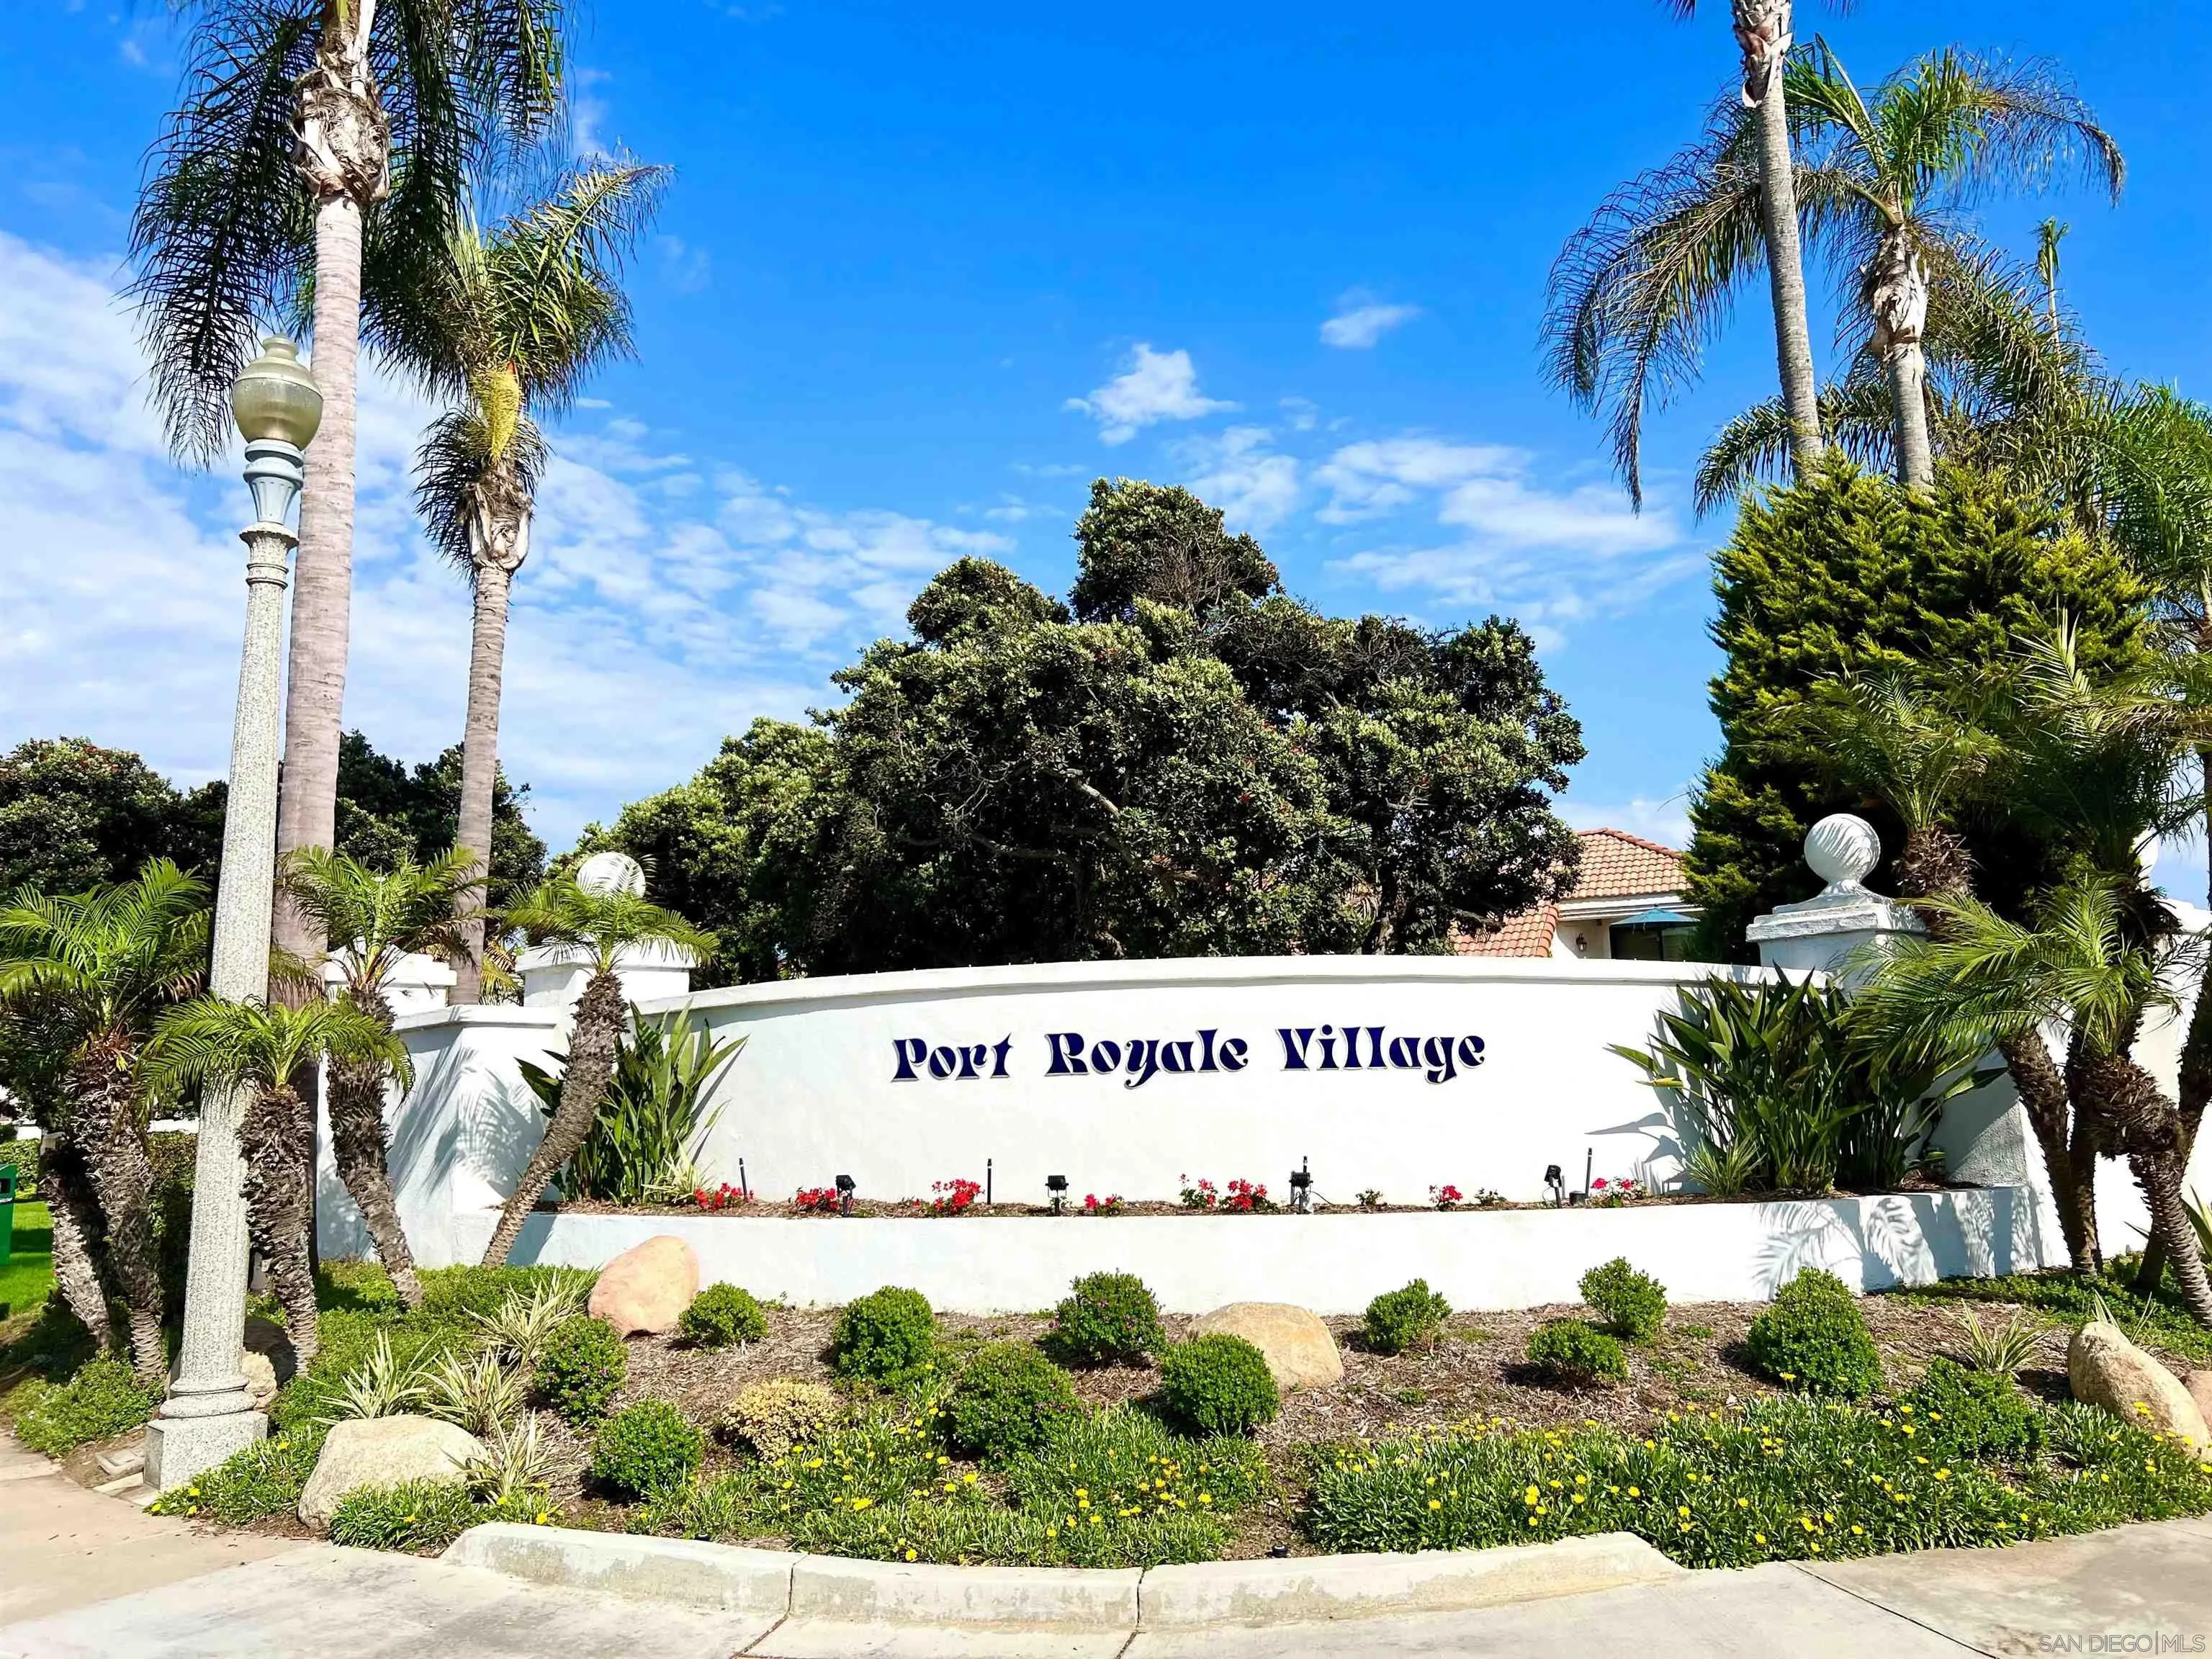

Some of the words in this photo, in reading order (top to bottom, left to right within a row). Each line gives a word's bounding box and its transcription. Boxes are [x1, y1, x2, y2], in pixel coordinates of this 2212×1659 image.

[891, 1032, 1013, 1082] Port
[1046, 1028, 1249, 1089] Royale
[1276, 1024, 1485, 1085] Village
